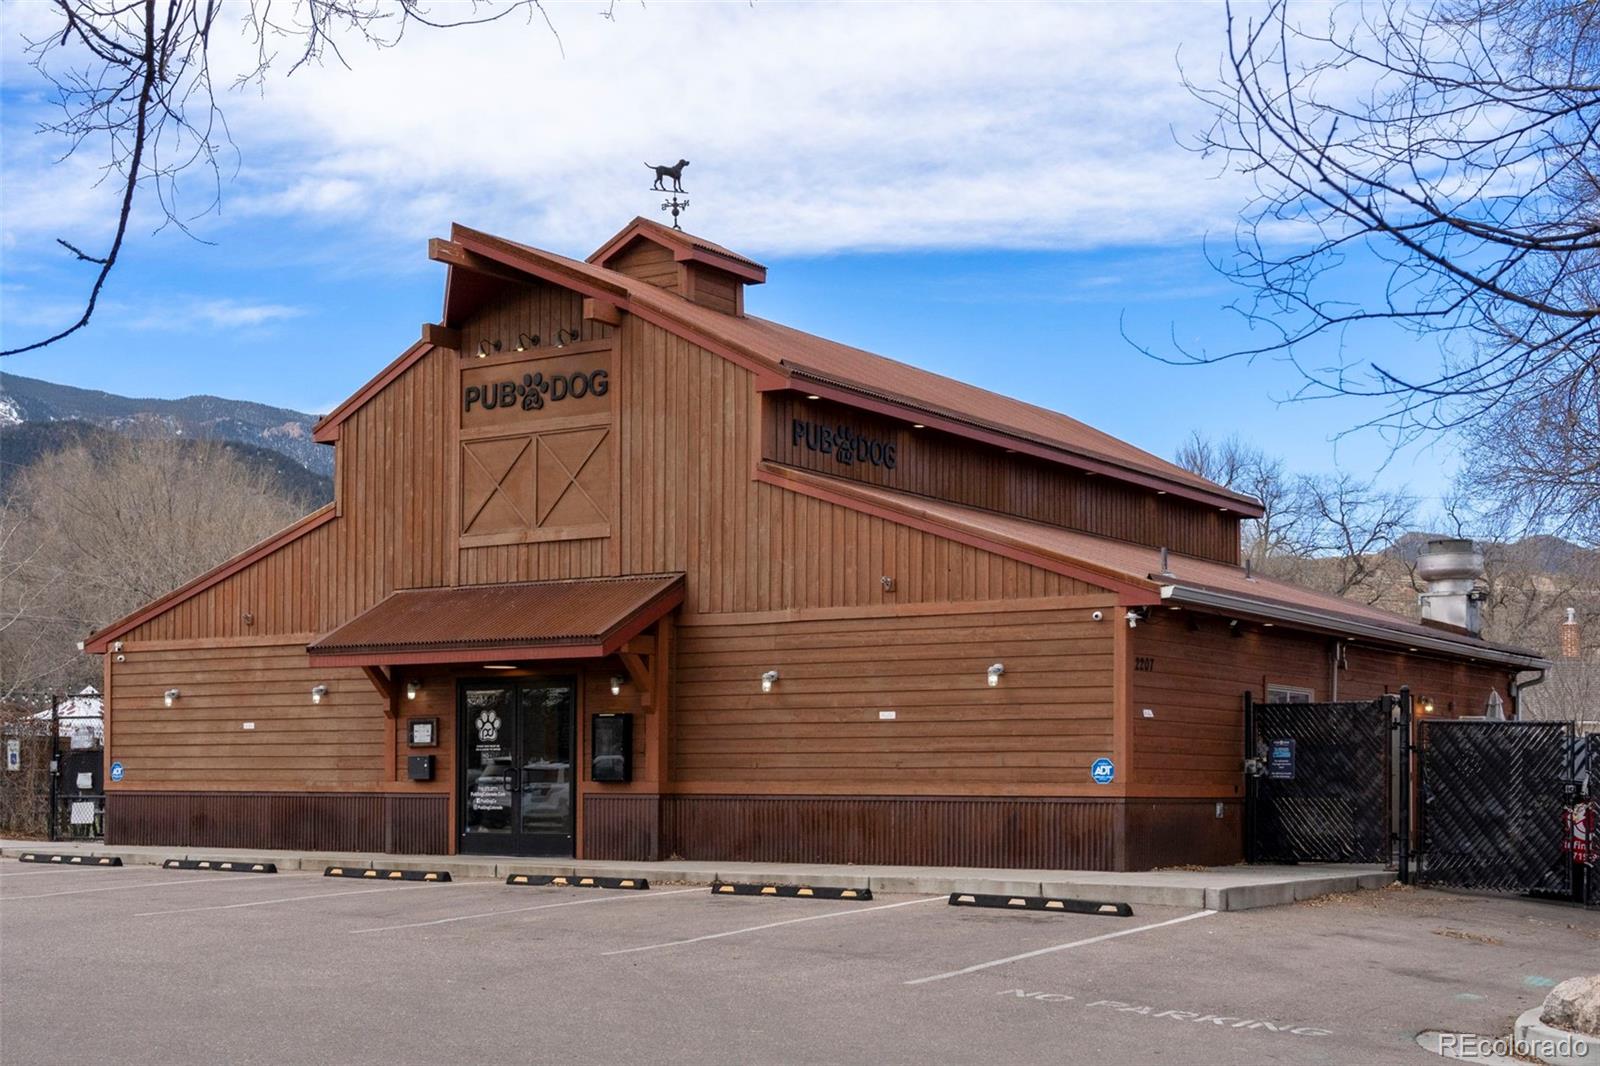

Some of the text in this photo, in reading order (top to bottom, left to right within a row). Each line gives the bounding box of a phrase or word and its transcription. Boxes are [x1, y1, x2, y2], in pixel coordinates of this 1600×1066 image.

[464, 369, 609, 412] PUB DOG
[792, 418, 897, 470] PUB DOG
[1135, 656, 1154, 672] 2207
[1094, 765, 1113, 776] ADT
[996, 988, 1335, 1037] NO PARKING
